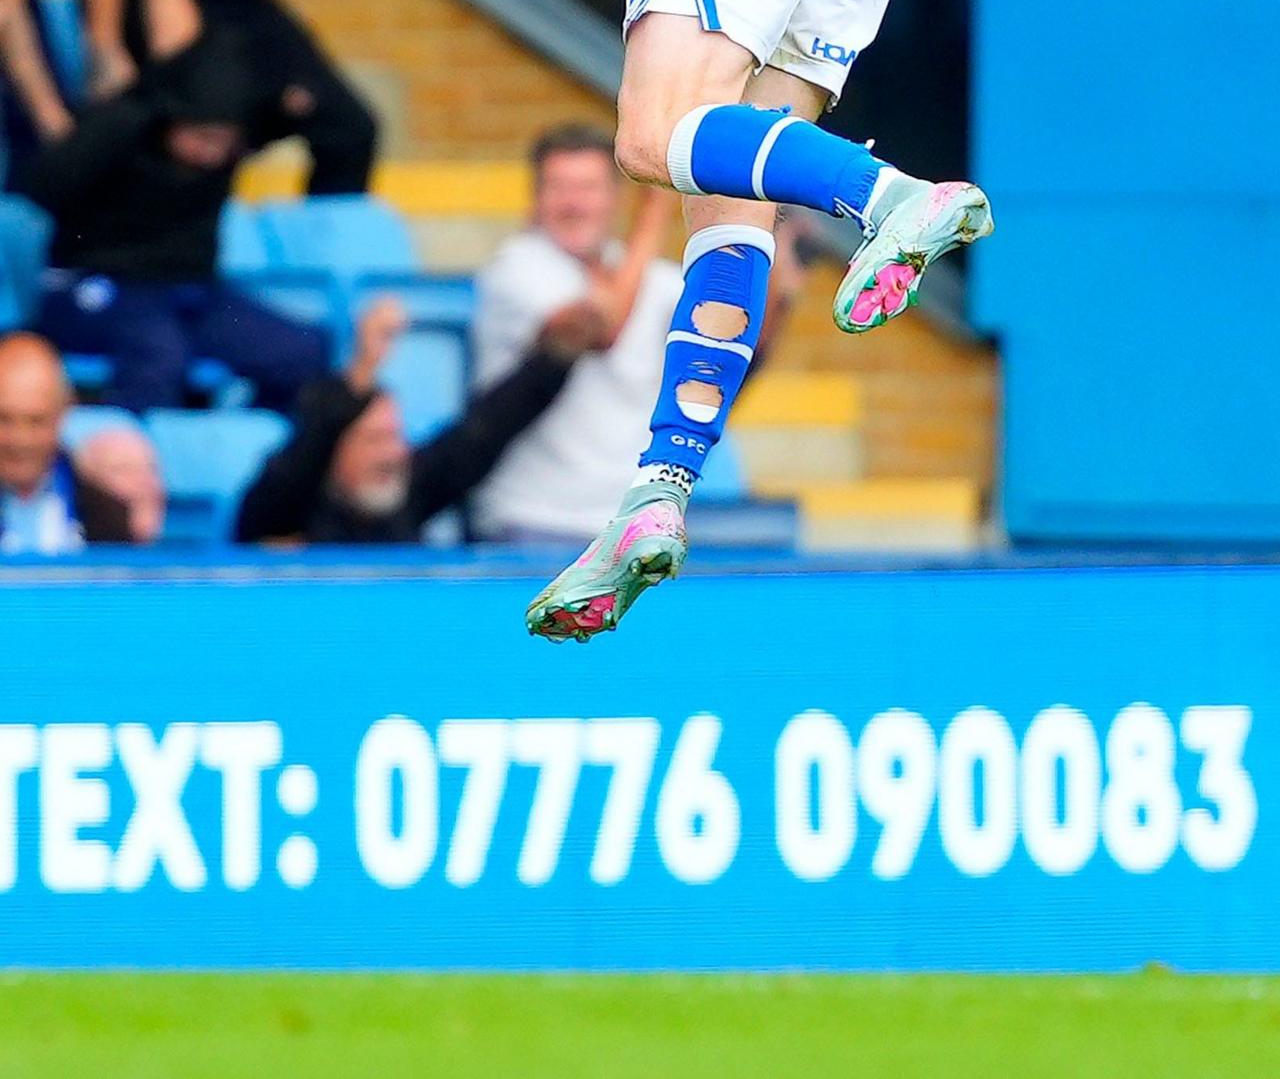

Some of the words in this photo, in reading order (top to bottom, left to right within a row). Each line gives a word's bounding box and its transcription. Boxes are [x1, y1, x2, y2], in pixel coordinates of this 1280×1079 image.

[671, 434, 706, 455] GFC
[354, 712, 743, 890] 07776
[773, 701, 1260, 883] 090083
